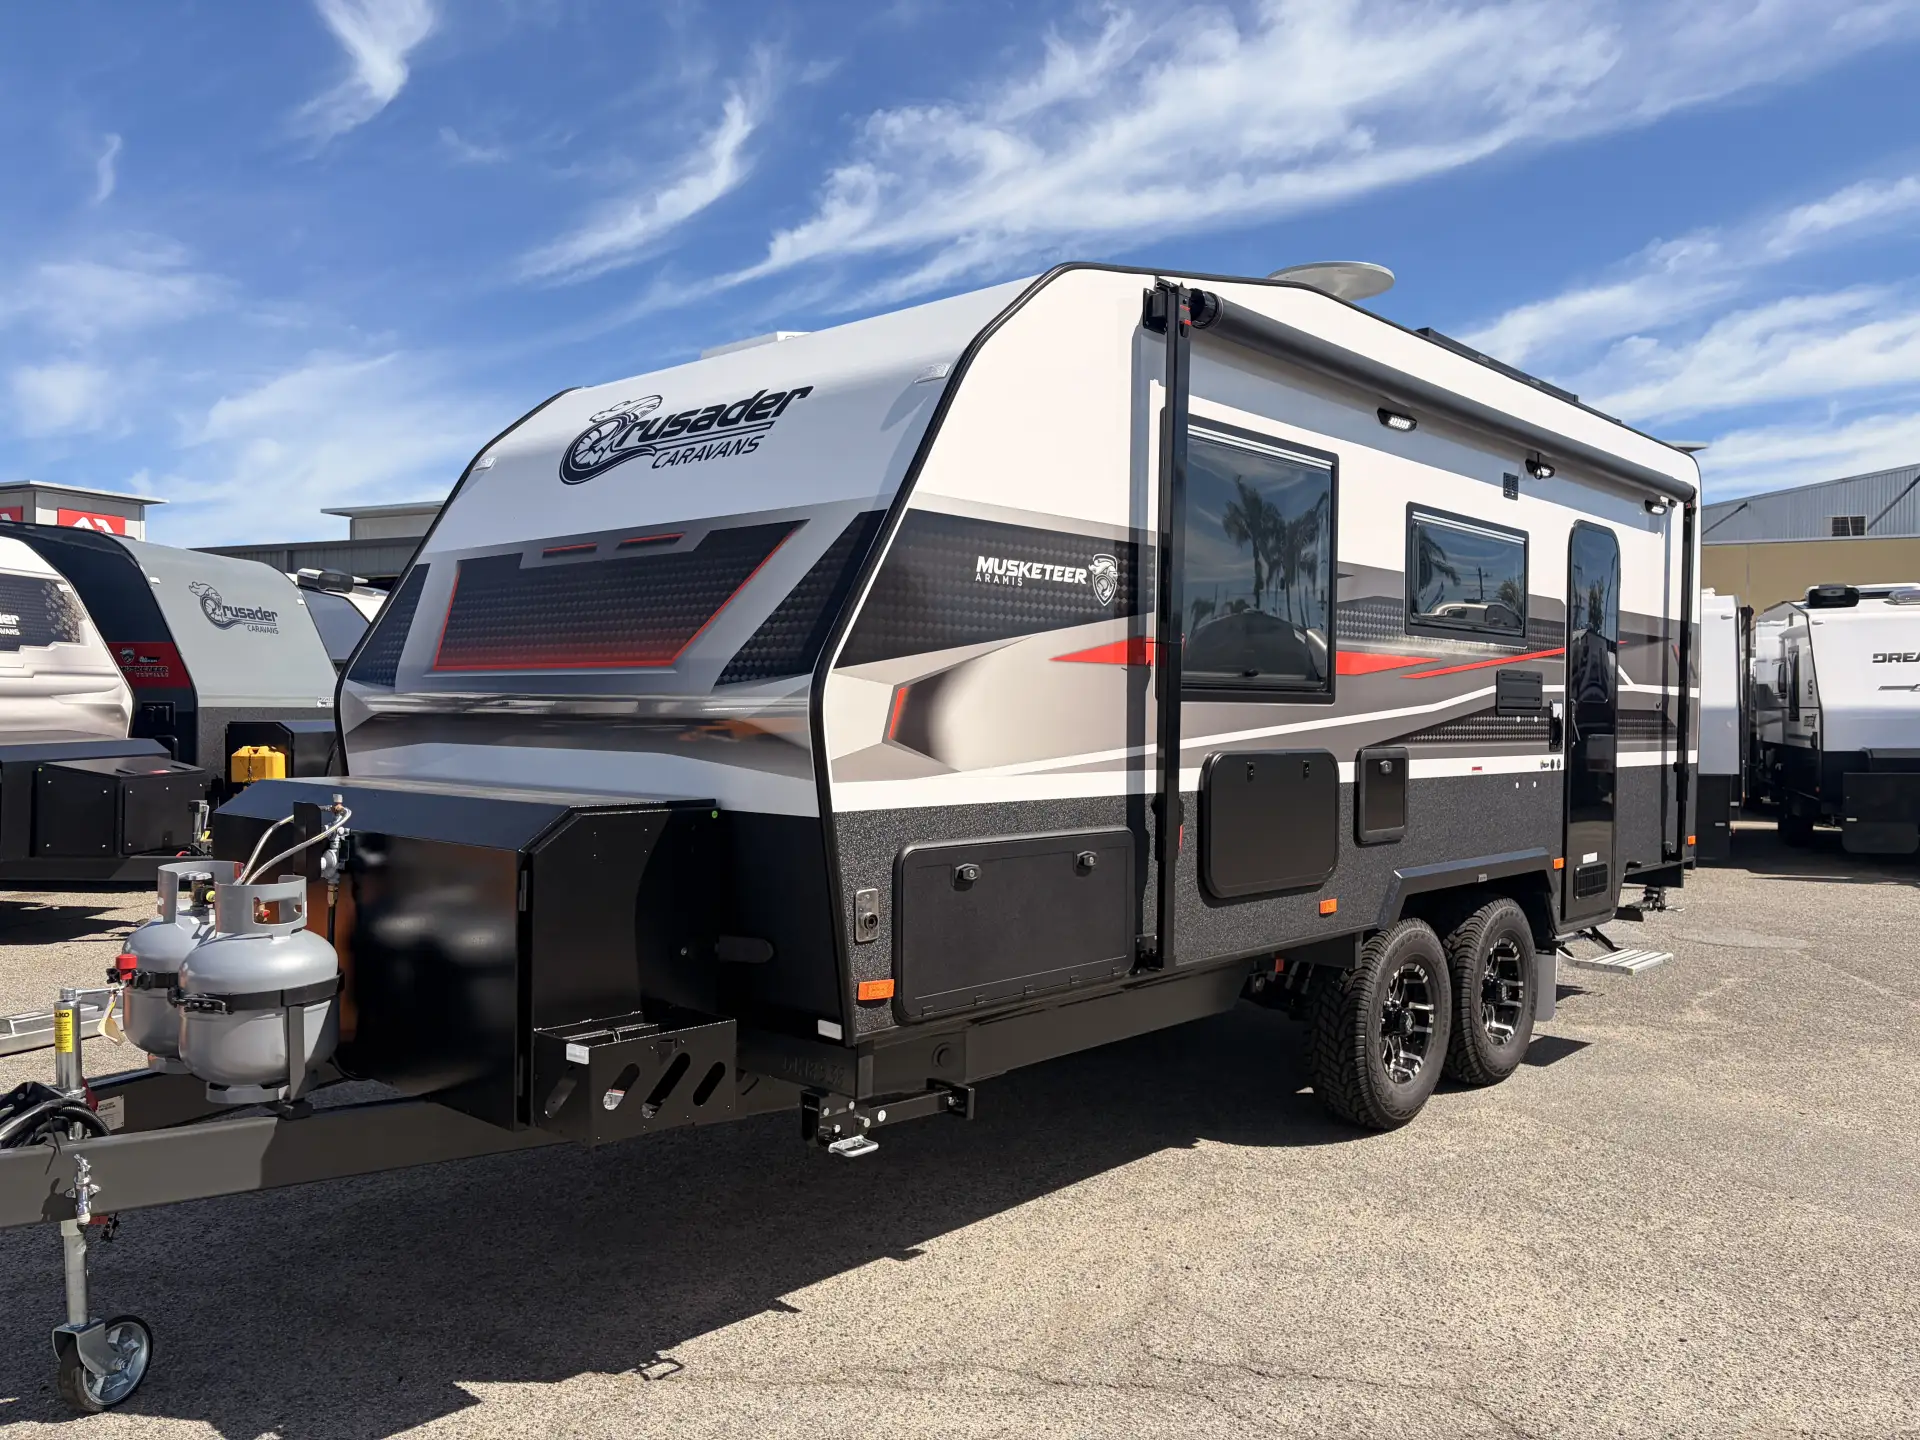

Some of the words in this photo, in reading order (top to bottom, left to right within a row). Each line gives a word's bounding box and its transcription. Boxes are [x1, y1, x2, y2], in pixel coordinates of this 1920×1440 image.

[651, 434, 766, 470] CARAVANS
[975, 555, 1088, 585] MUSKETEER
[975, 572, 1023, 587] ARAMIS
[247, 624, 279, 635] CARAVANS
